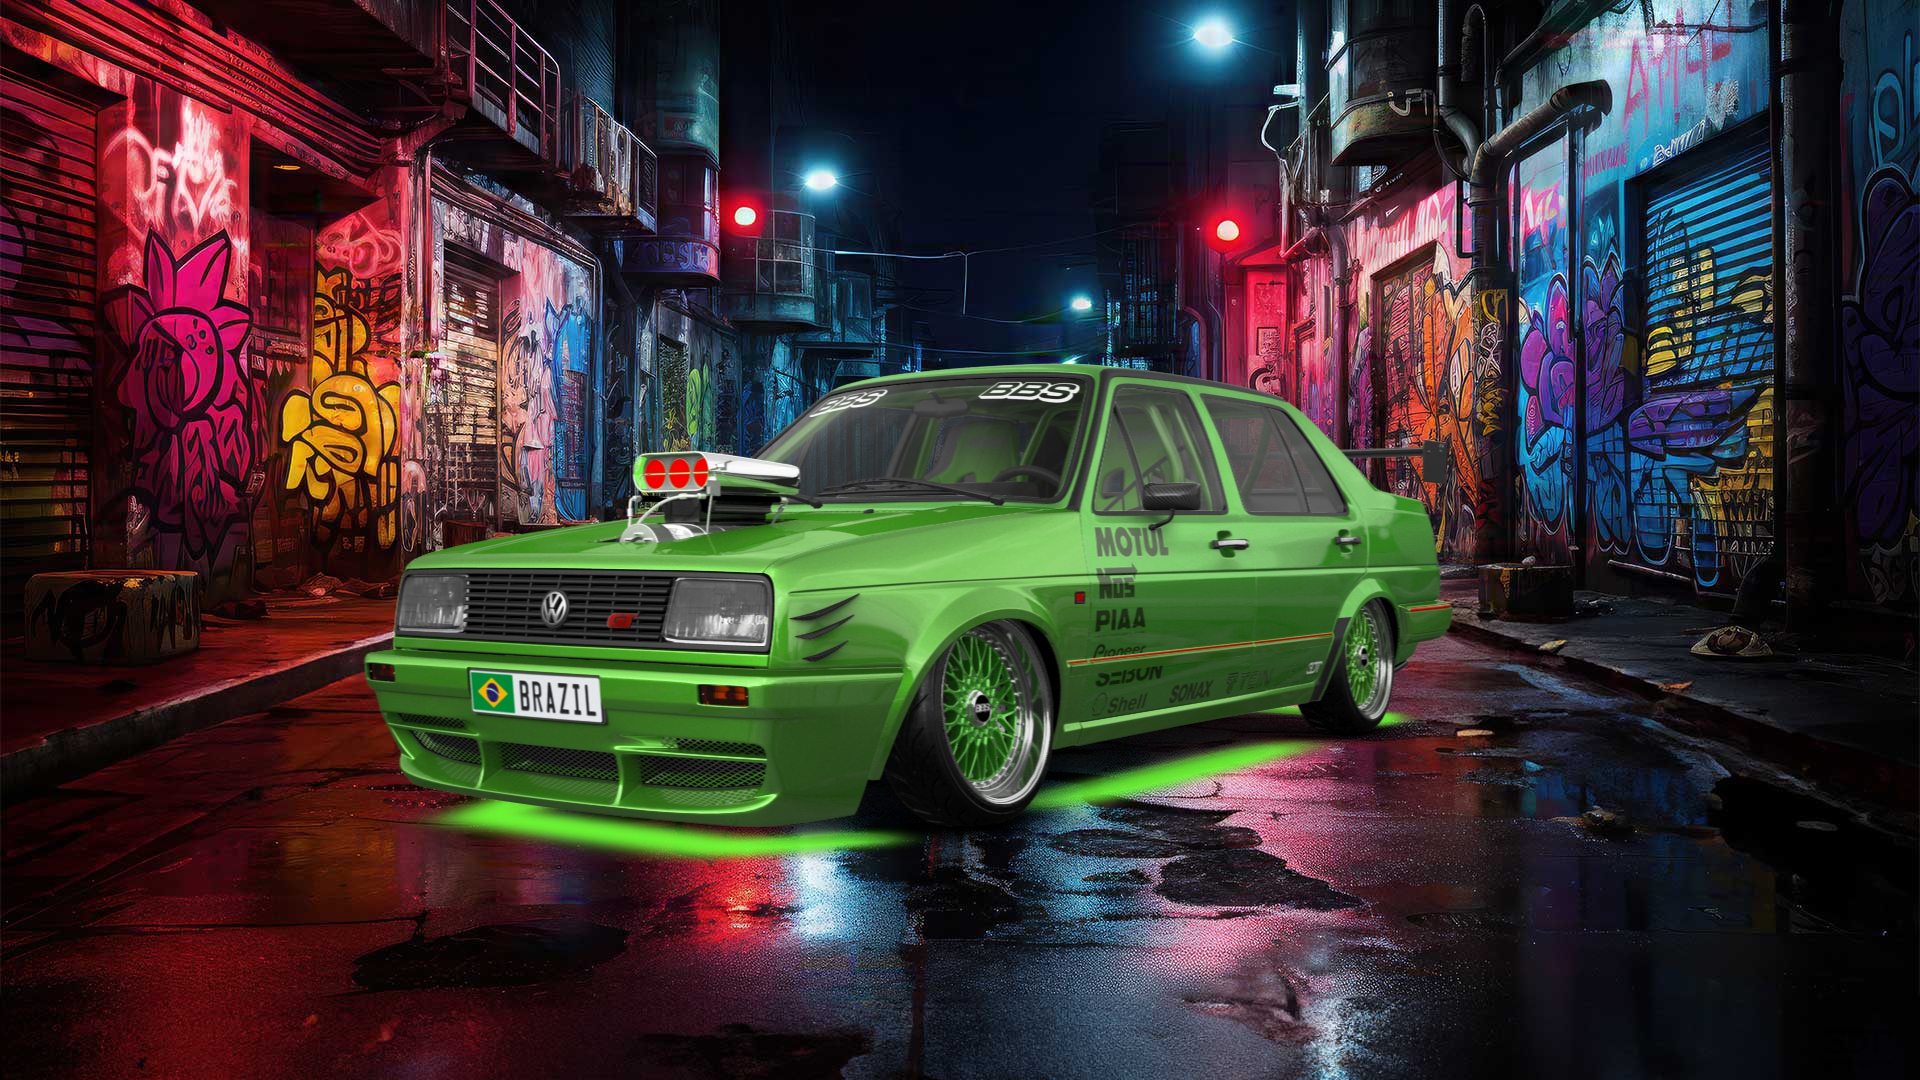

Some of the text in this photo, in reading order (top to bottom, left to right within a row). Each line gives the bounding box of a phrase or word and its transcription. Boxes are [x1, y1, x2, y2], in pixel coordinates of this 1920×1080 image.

[809, 389, 888, 418] BBS
[978, 382, 1081, 403] BBS
[1094, 526, 1169, 557] MOTUL
[1096, 565, 1137, 599] NOS
[606, 612, 640, 629] GT
[1095, 607, 1146, 632] PIAA
[519, 680, 597, 717] BRAZIL
[1107, 693, 1148, 713] Shell
[1169, 680, 1214, 703] SONAX
